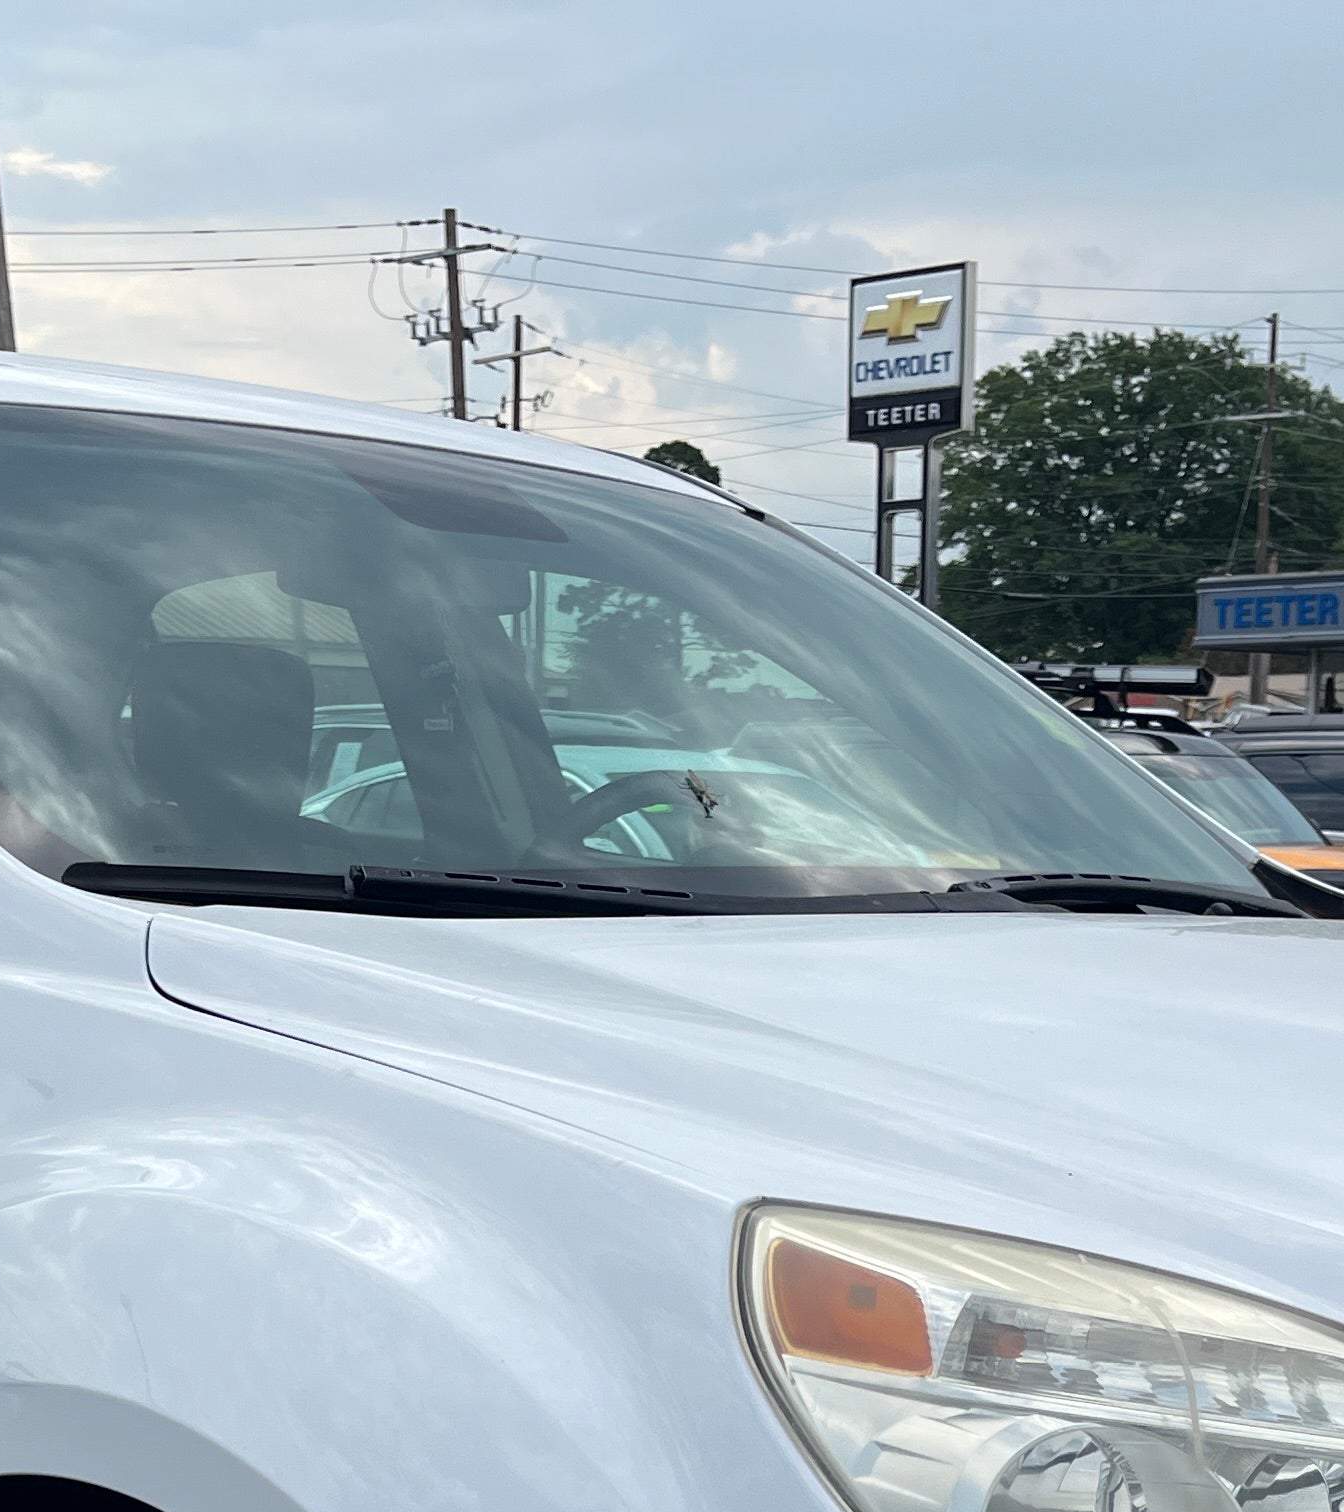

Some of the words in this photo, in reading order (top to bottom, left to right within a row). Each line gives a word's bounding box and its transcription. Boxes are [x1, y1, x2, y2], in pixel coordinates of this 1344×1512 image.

[855, 351, 953, 382] CHEVROLET
[866, 403, 941, 427] TEETER
[1214, 594, 1339, 630] TEETER
